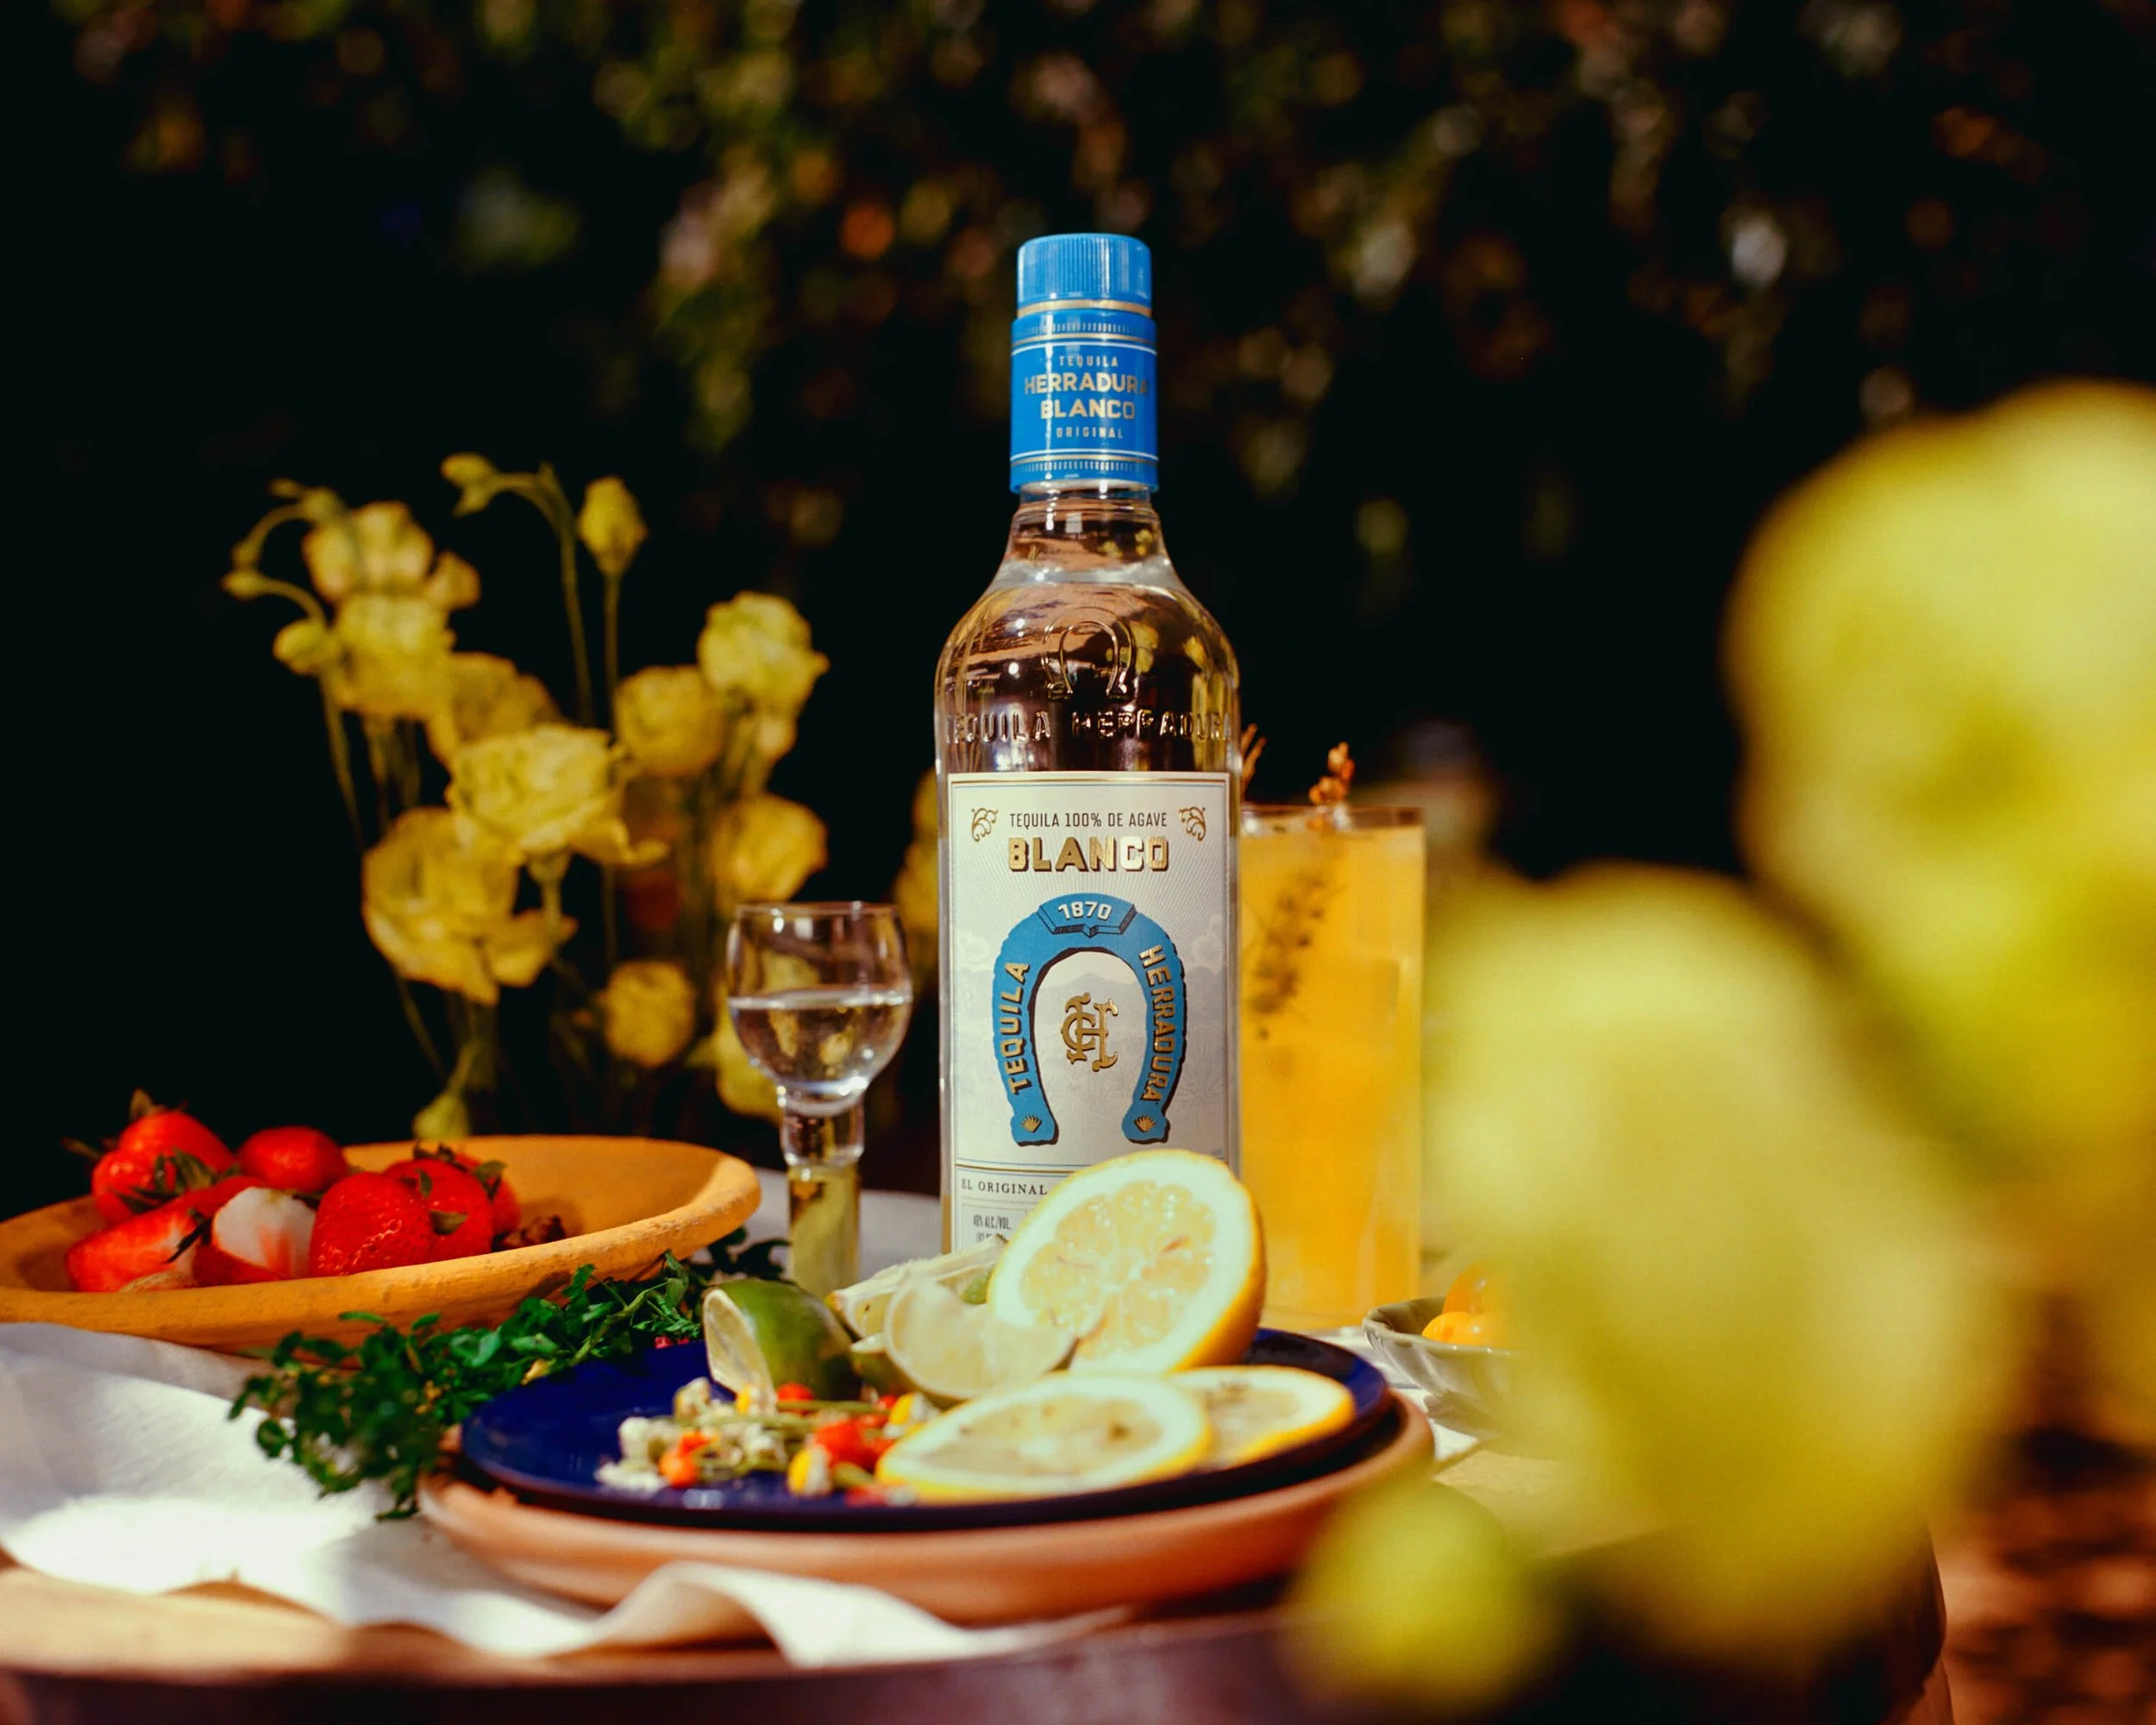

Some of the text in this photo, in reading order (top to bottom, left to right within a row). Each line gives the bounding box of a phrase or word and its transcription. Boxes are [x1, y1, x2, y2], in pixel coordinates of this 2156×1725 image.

[1059, 355, 1118, 367] TEQUILA
[1025, 372, 1148, 395] HERRADURA
[1040, 398, 1135, 419] BLANCO
[1056, 427, 1123, 438] ORIGINAL
[1010, 812, 1167, 827] TEQUILA 100% DE AGAVE
[1008, 836, 1169, 872] BLANCO
[1058, 901, 1112, 920] 1870
[1000, 962, 1032, 1095] TEQUILA
[1139, 944, 1175, 1101] HERRADURA
[962, 1178, 1048, 1195] EL ORIGINAL
